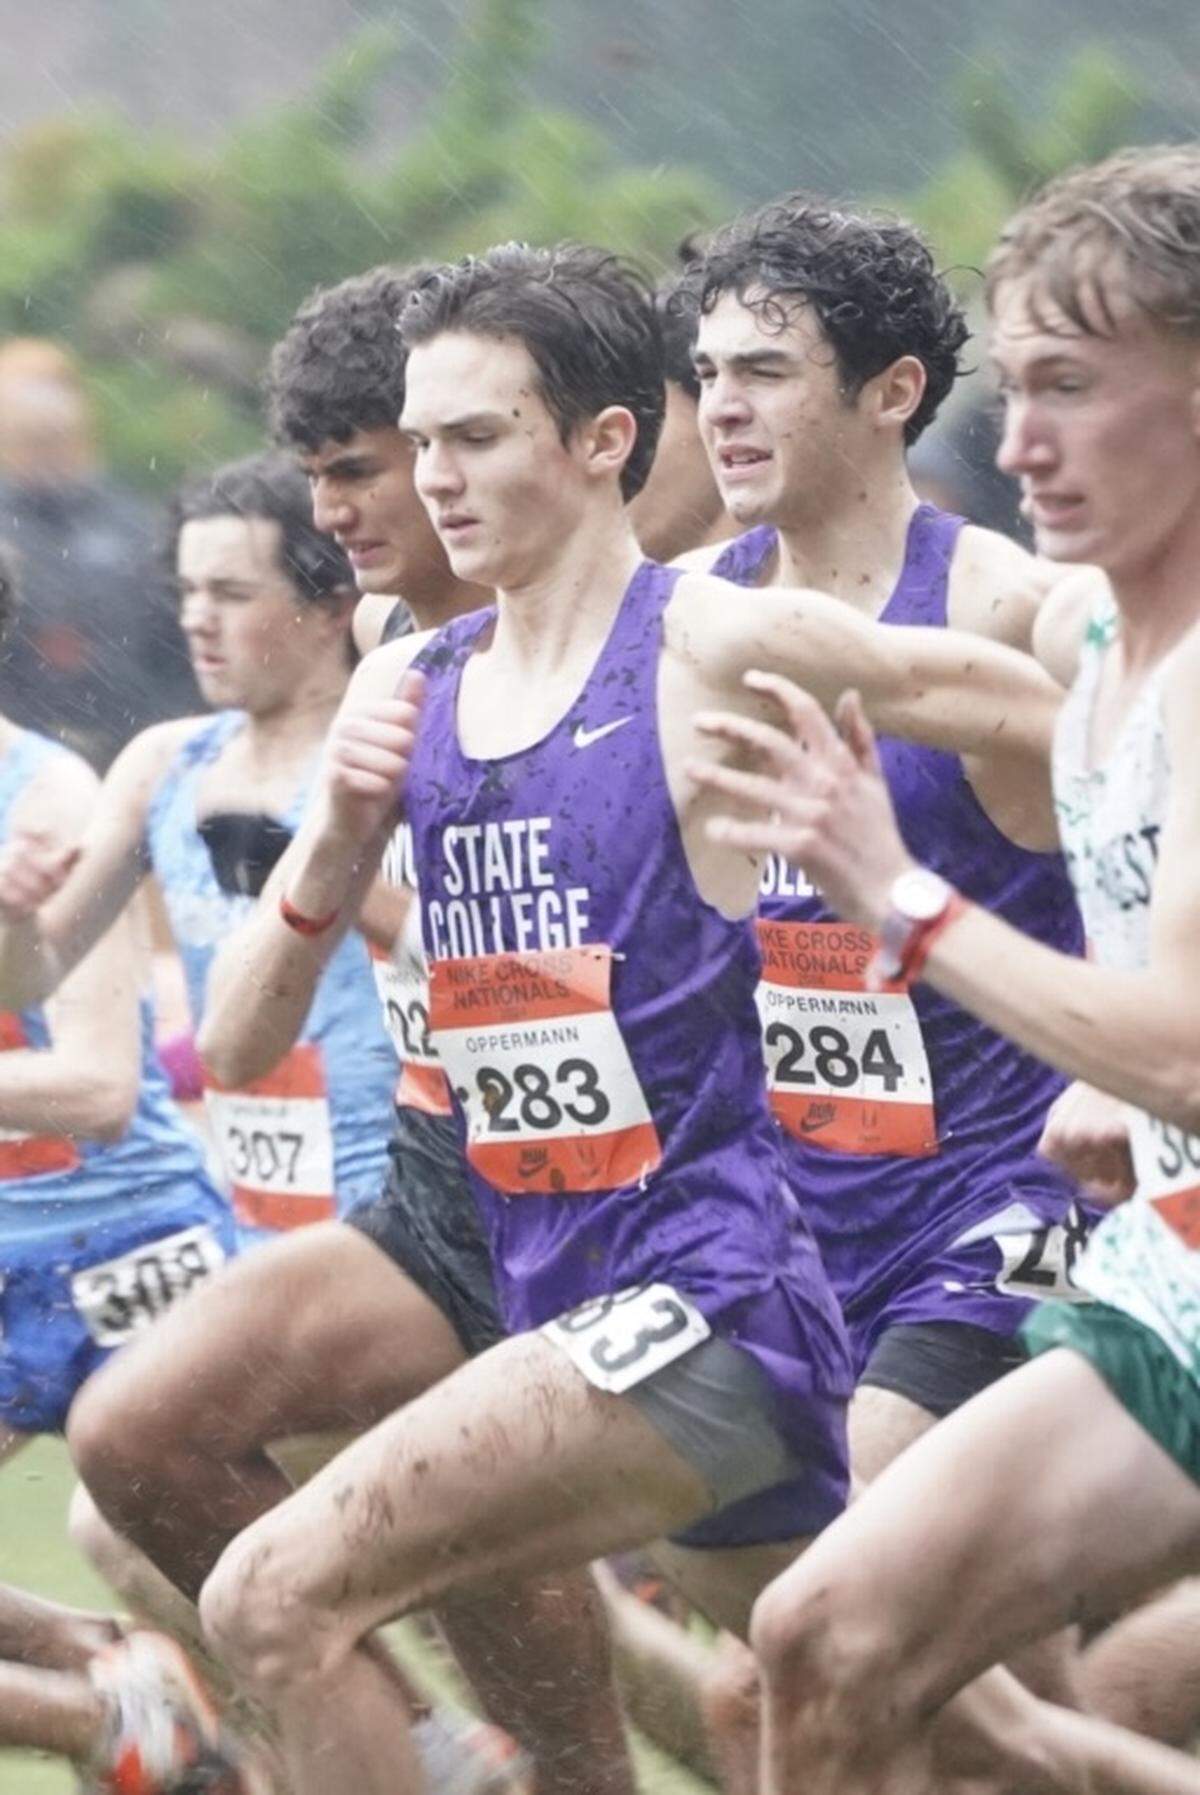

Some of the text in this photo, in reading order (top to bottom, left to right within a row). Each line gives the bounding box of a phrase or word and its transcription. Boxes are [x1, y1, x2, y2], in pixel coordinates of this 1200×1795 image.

[443, 818, 554, 896] STATE
[429, 887, 590, 961] COLLEGE
[795, 930, 873, 952] CROSS
[447, 963, 490, 985] NIKE
[495, 954, 574, 982] CROSS
[766, 950, 867, 975] ATIONALS
[454, 980, 571, 1009] NATIONALS
[766, 990, 878, 1015] OPPERMANN
[466, 1026, 580, 1053] OPPERMANN
[765, 1020, 904, 1092] 284
[476, 1058, 610, 1133] 283
[228, 1126, 304, 1183] 307
